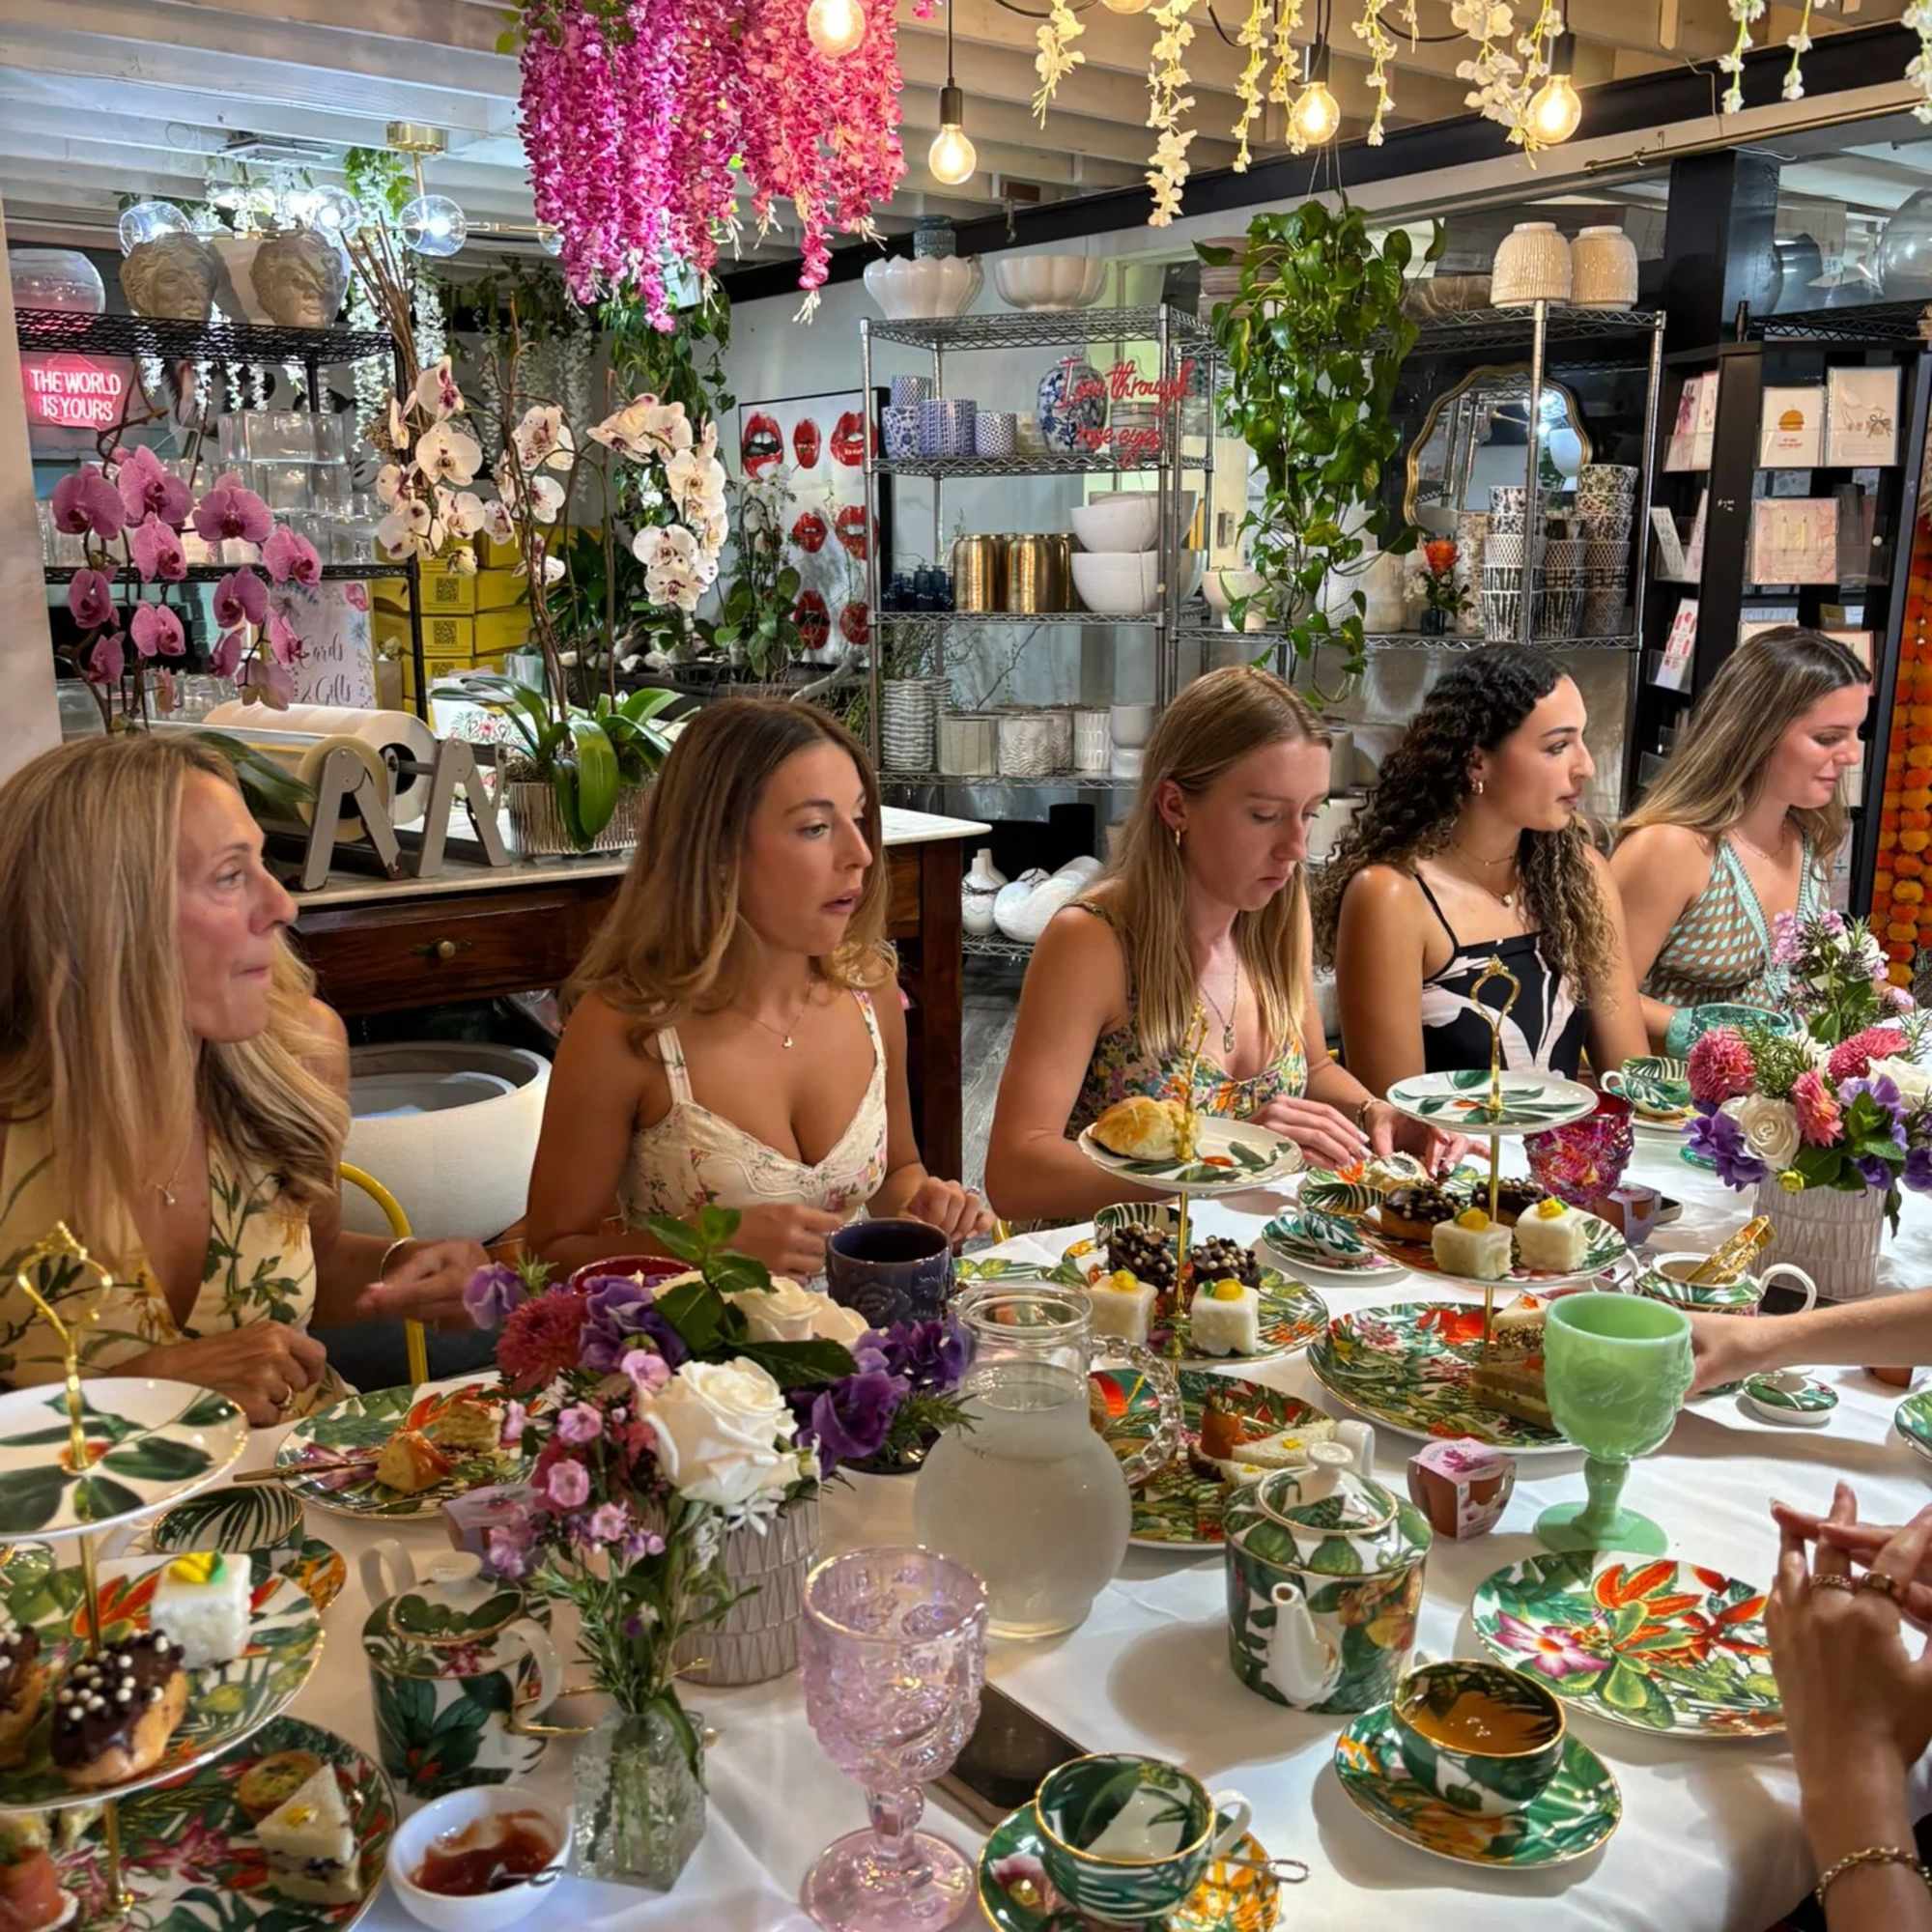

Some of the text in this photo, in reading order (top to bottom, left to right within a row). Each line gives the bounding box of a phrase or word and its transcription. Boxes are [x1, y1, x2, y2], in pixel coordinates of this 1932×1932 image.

[30, 369, 122, 396] THE WORLD
[1105, 357, 1196, 417] through
[42, 395, 114, 422] IS YOURS
